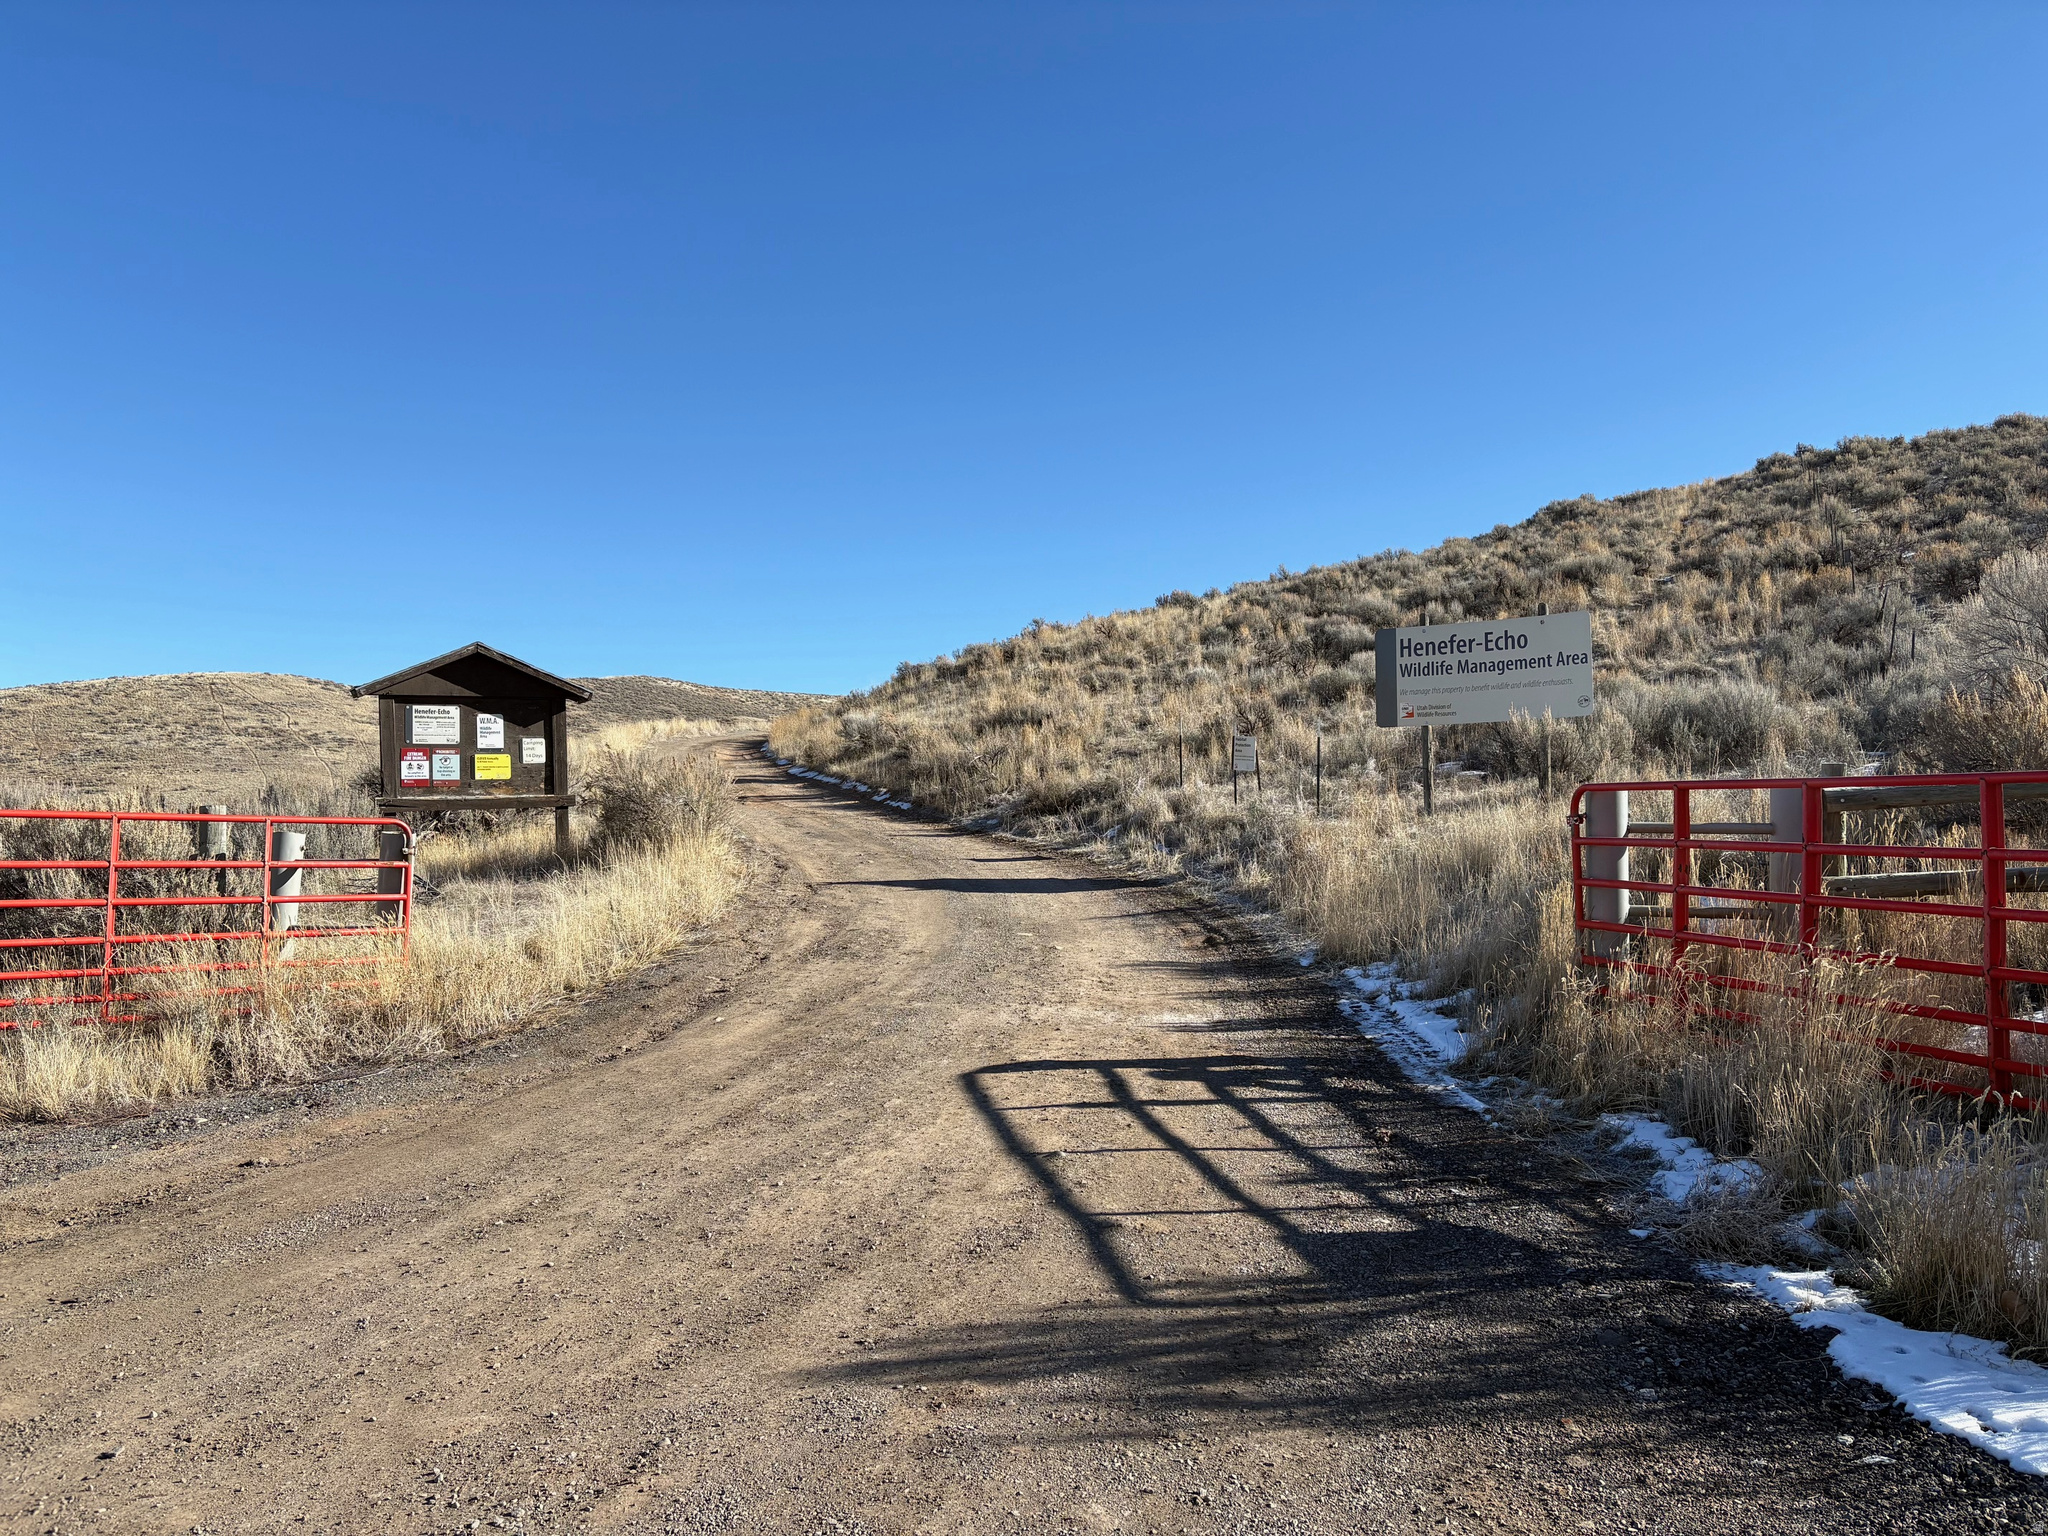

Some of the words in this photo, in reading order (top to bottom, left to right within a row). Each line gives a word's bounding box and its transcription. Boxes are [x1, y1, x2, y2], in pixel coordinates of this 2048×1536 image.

[1400, 629, 1528, 658] Henefer-Echo
[1399, 660, 1454, 678] Wildlife
[1457, 654, 1553, 676] Management
[1556, 651, 1588, 667] Area
[1399, 688, 1408, 696] We
[1408, 688, 1431, 697] manage
[1431, 686, 1441, 694] this
[1441, 686, 1465, 695] property
[1464, 685, 1471, 693] to
[1471, 682, 1490, 692] benefit
[1490, 681, 1510, 690] wildlife
[1510, 681, 1522, 689] and
[1522, 679, 1542, 688] wildlife
